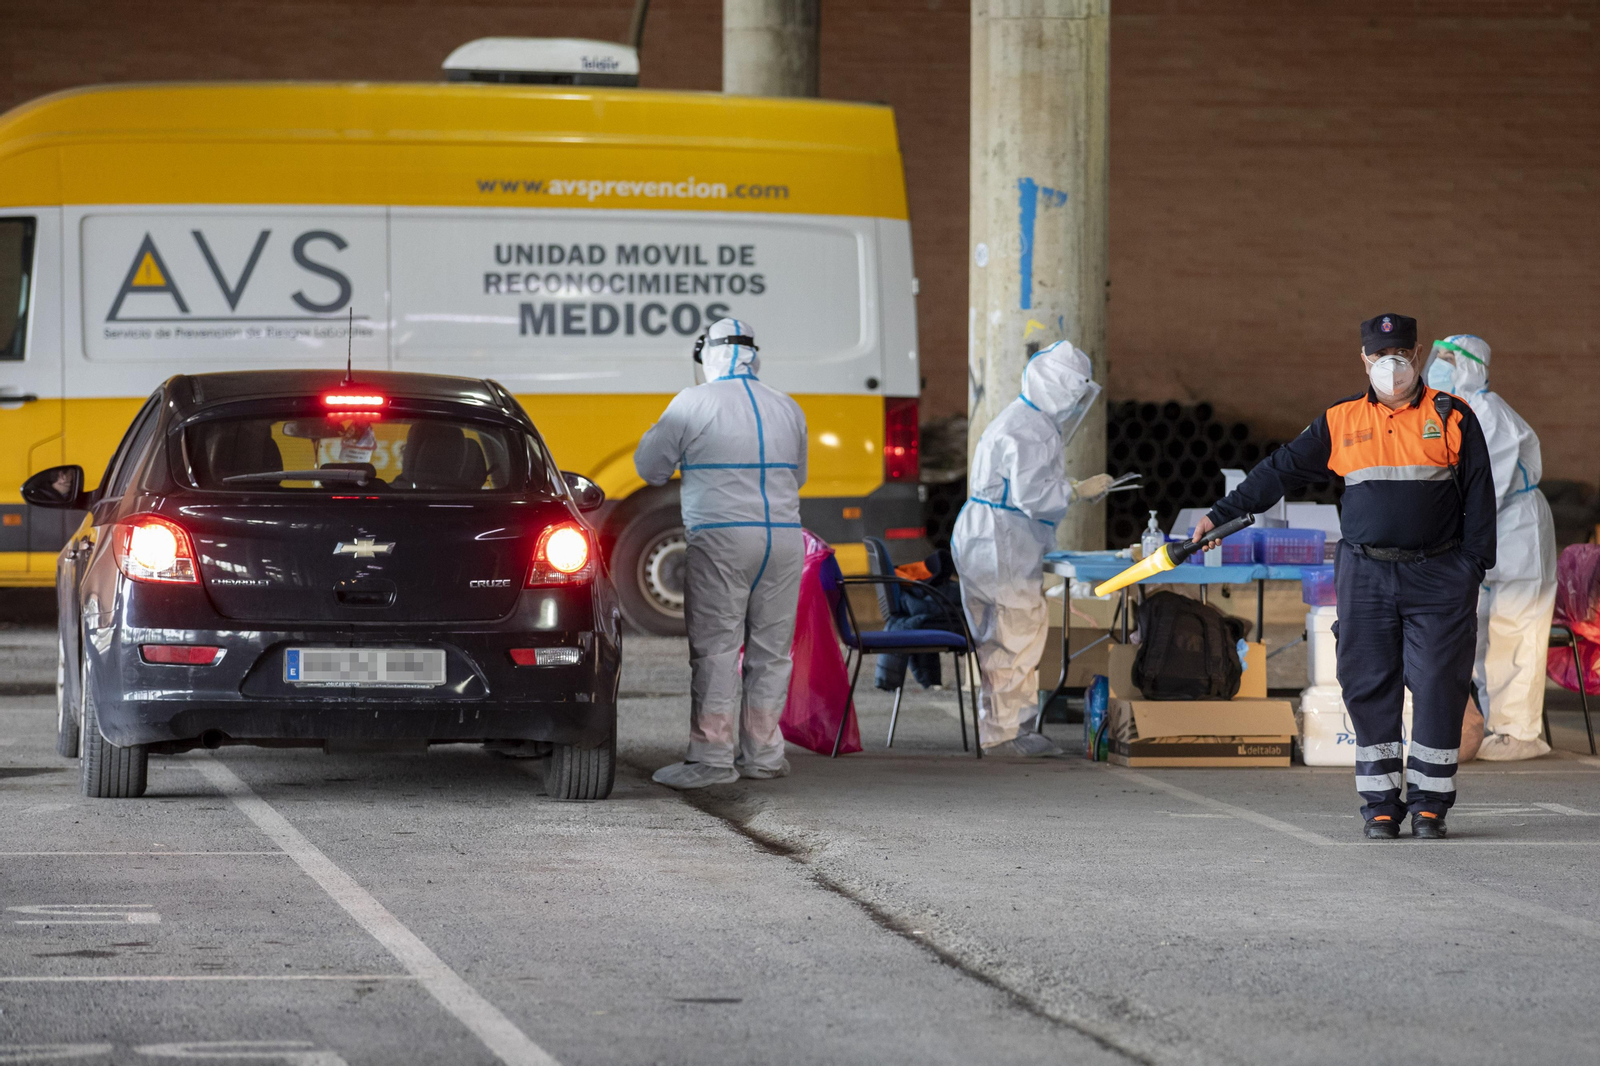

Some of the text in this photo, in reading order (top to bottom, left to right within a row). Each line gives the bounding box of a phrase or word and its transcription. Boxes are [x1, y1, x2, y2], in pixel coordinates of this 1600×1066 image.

[477, 177, 790, 200] www.avsprevencion.com
[494, 243, 756, 266] UNIDAD MOVIL DE
[105, 229, 353, 321] AVS
[483, 273, 766, 295] RECONOCIMIENTOS
[519, 302, 732, 337] MEDICOS
[470, 579, 511, 588] CRUZE
[290, 668, 296, 676] E
[1247, 744, 1281, 755] deltalab
